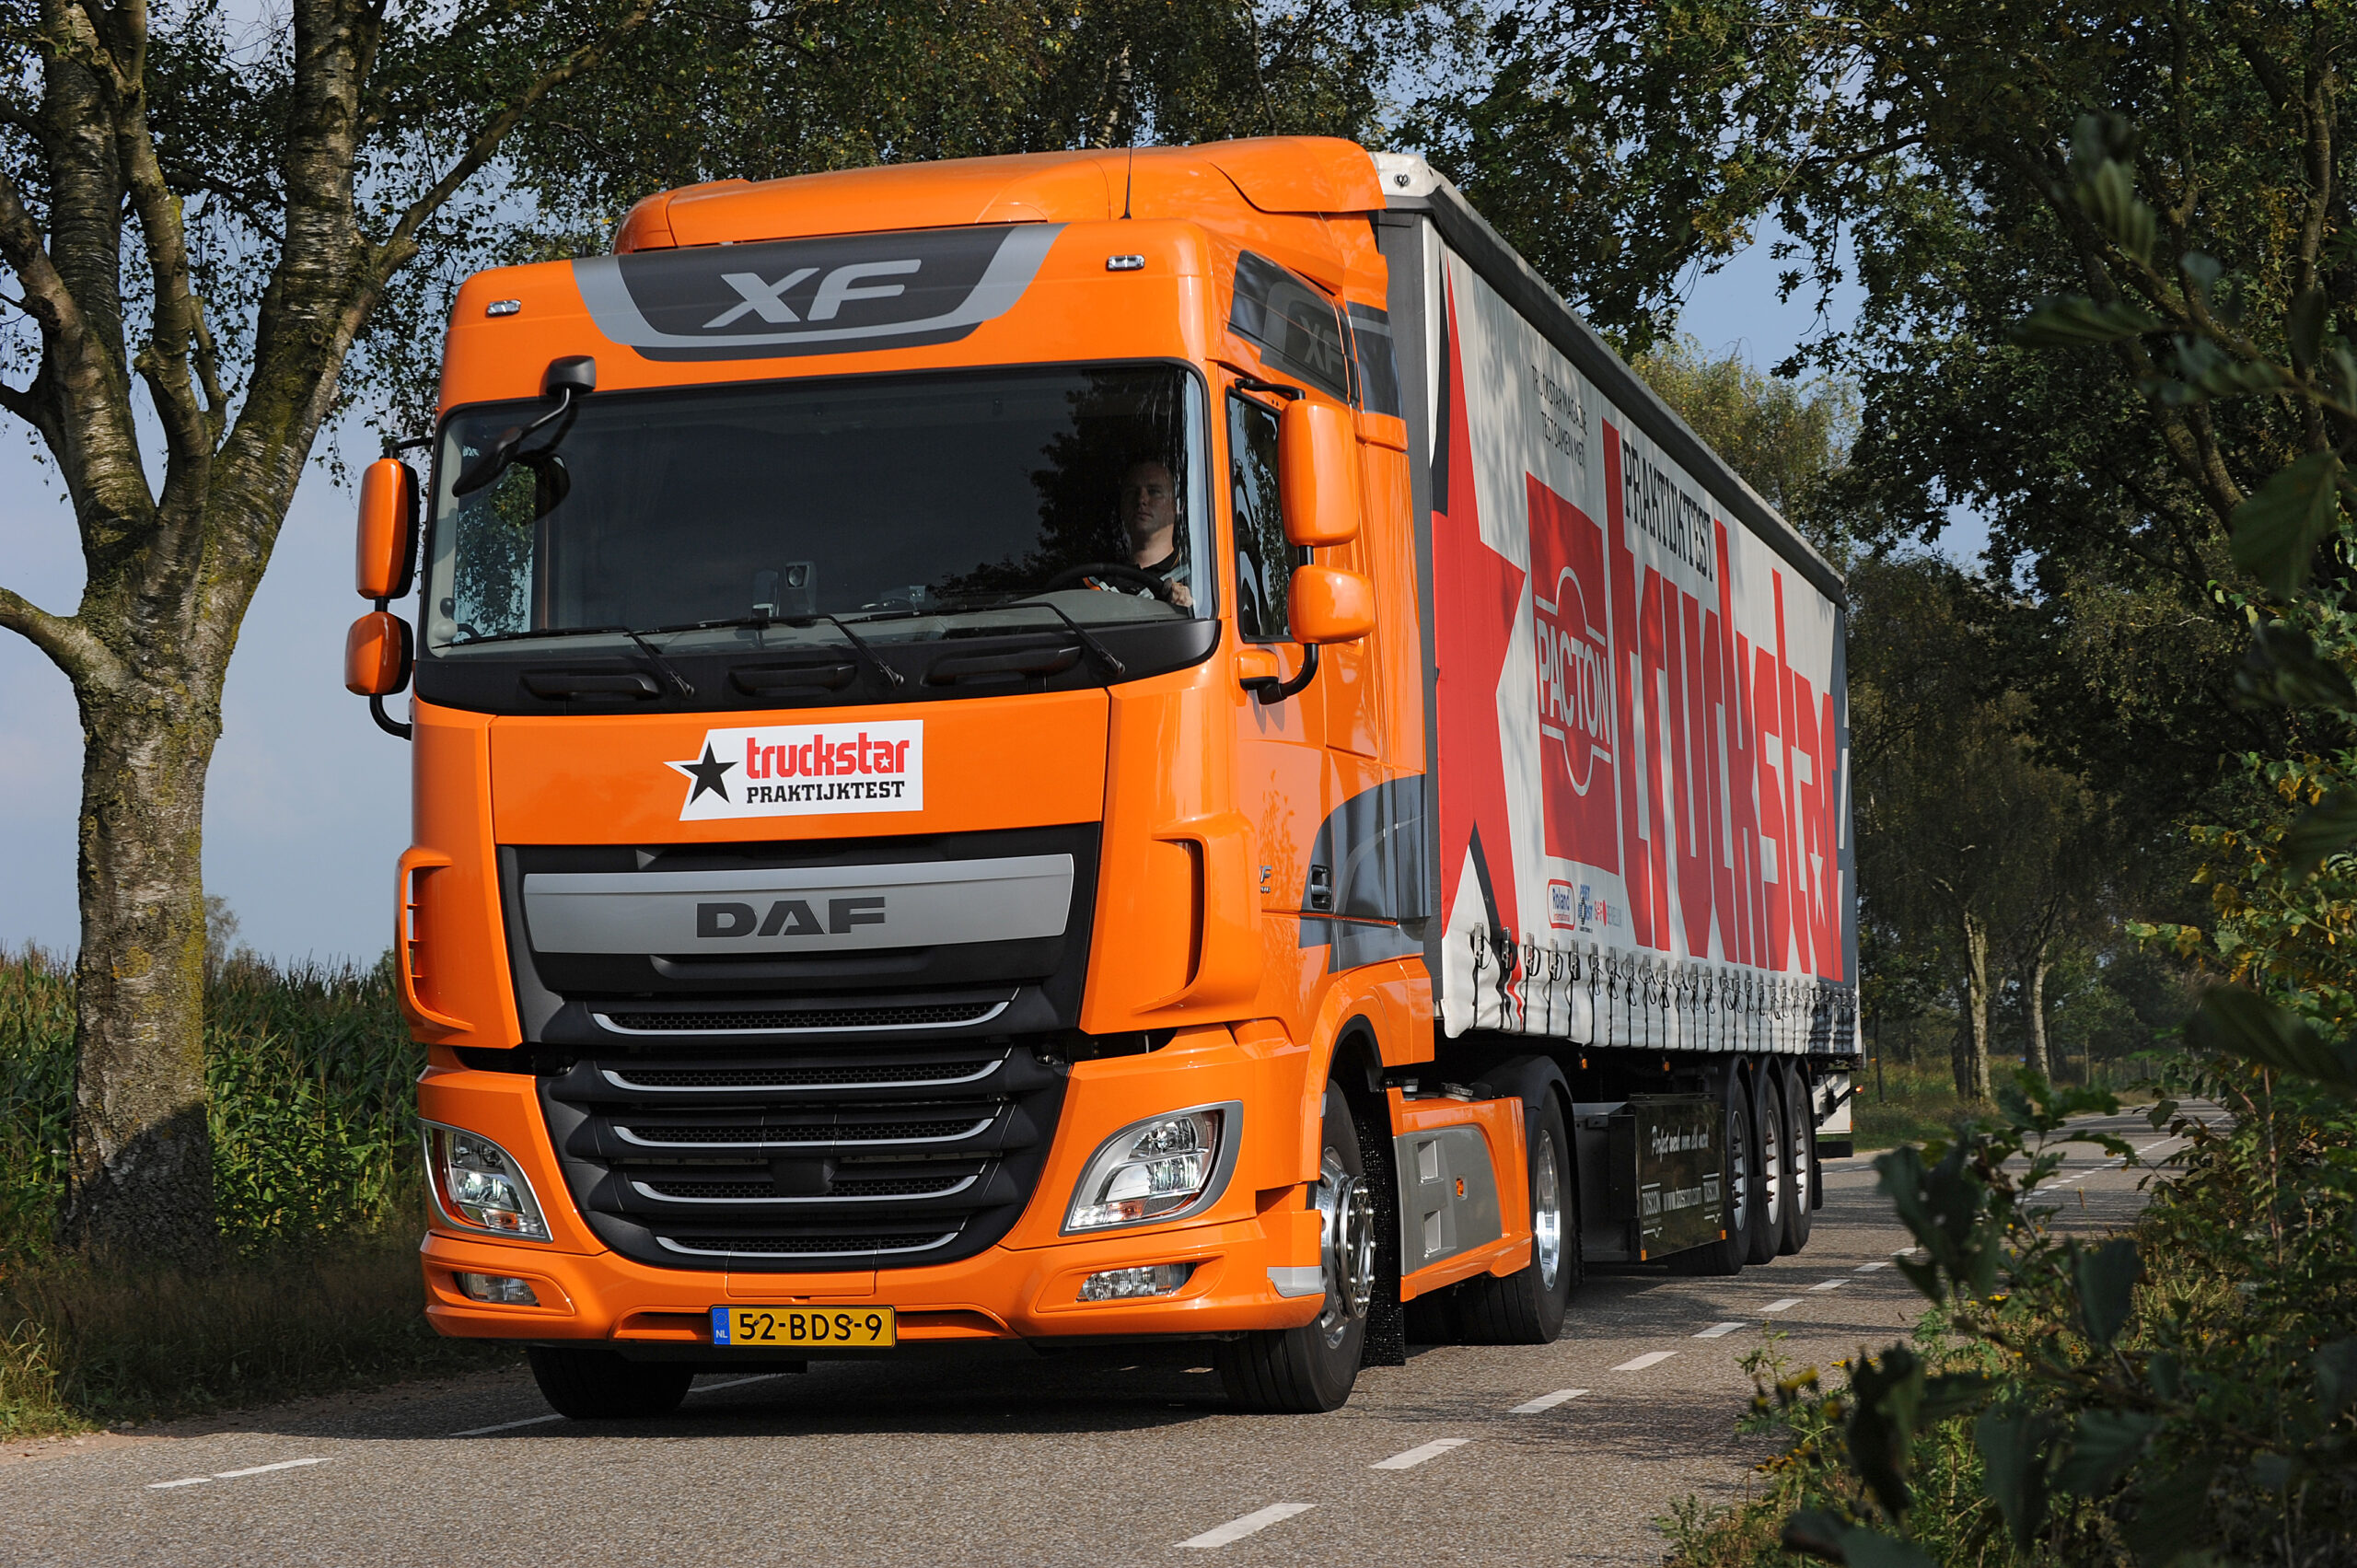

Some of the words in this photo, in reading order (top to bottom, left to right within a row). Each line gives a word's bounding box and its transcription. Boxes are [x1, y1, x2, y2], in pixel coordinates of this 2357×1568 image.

[702, 259, 922, 329] XF
[1299, 315, 1343, 375] XF
[1622, 438, 1713, 582] PRAKTIJKTEST
[1536, 617, 1611, 745] PACTON
[1602, 416, 1842, 982] truckstar
[747, 732, 910, 779] truckstar
[747, 781, 905, 804] PRAKTIJKTEST
[697, 896, 886, 938] DAF
[715, 1330, 728, 1339] NL
[739, 1313, 883, 1341] 52-BDS-9
